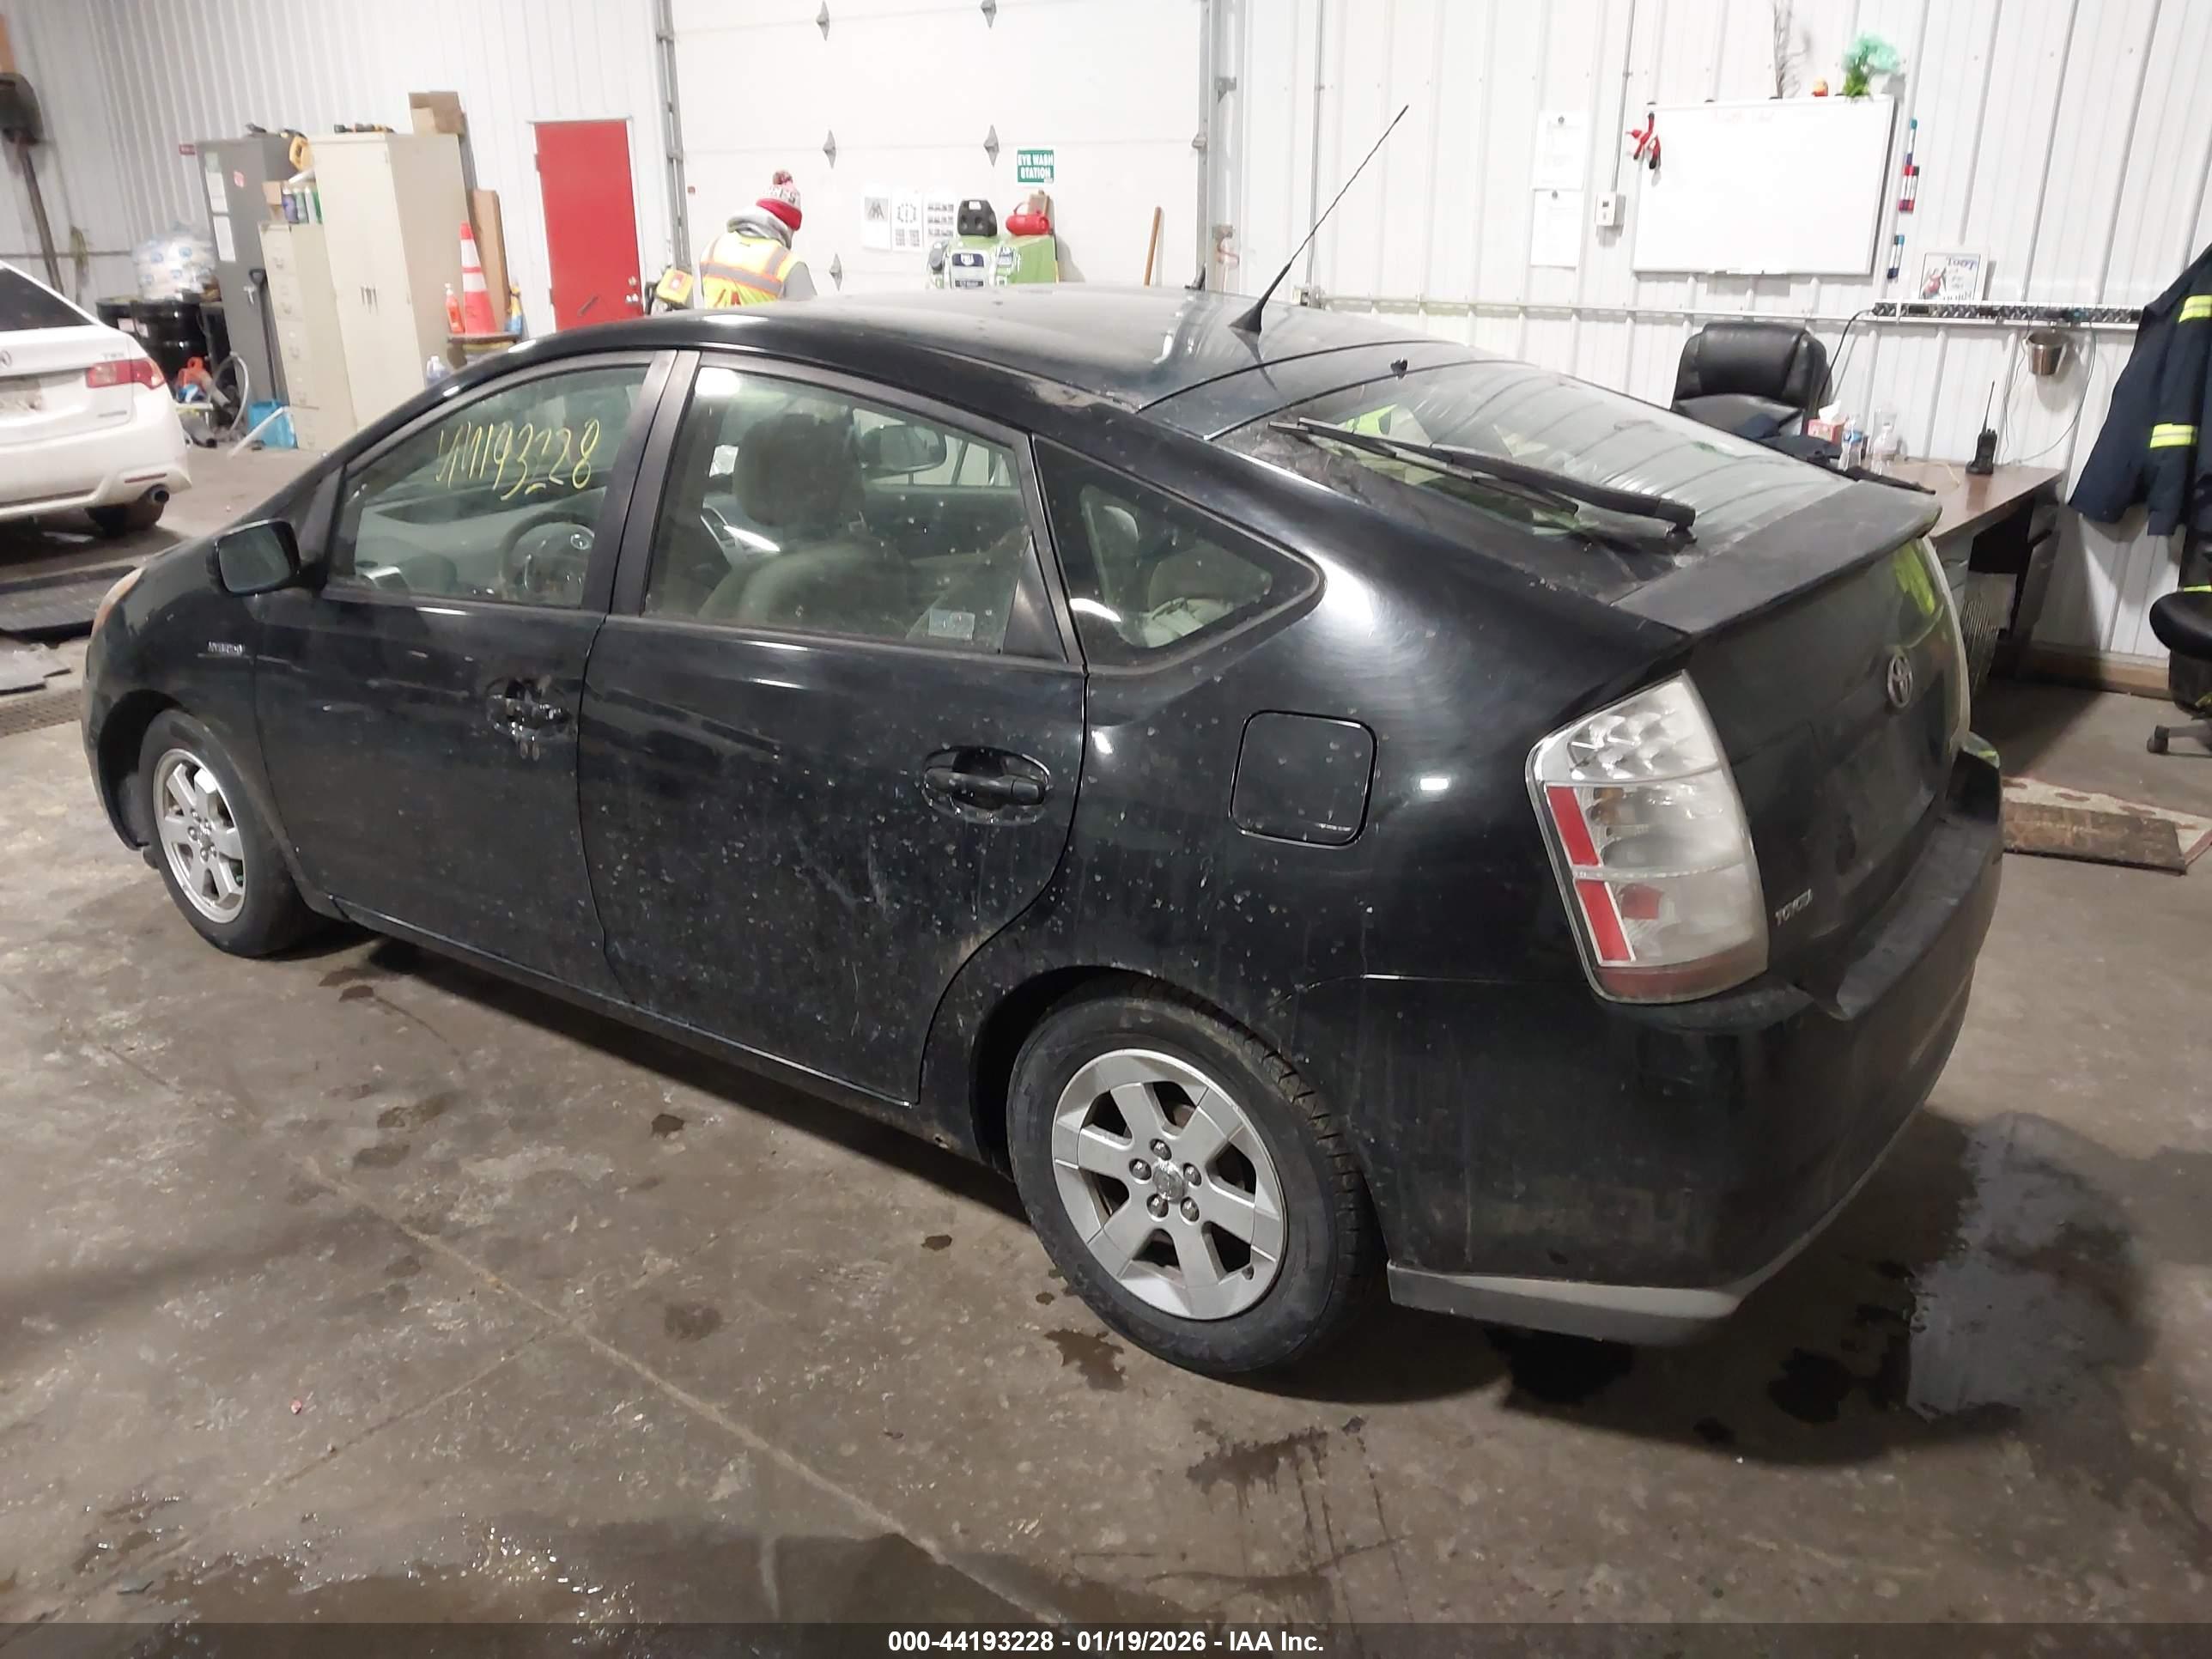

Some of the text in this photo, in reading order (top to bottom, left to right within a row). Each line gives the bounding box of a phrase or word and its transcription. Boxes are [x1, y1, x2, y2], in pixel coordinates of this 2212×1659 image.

[1017, 154, 1054, 166] EYE WASH
[1020, 167, 1051, 179] STATION
